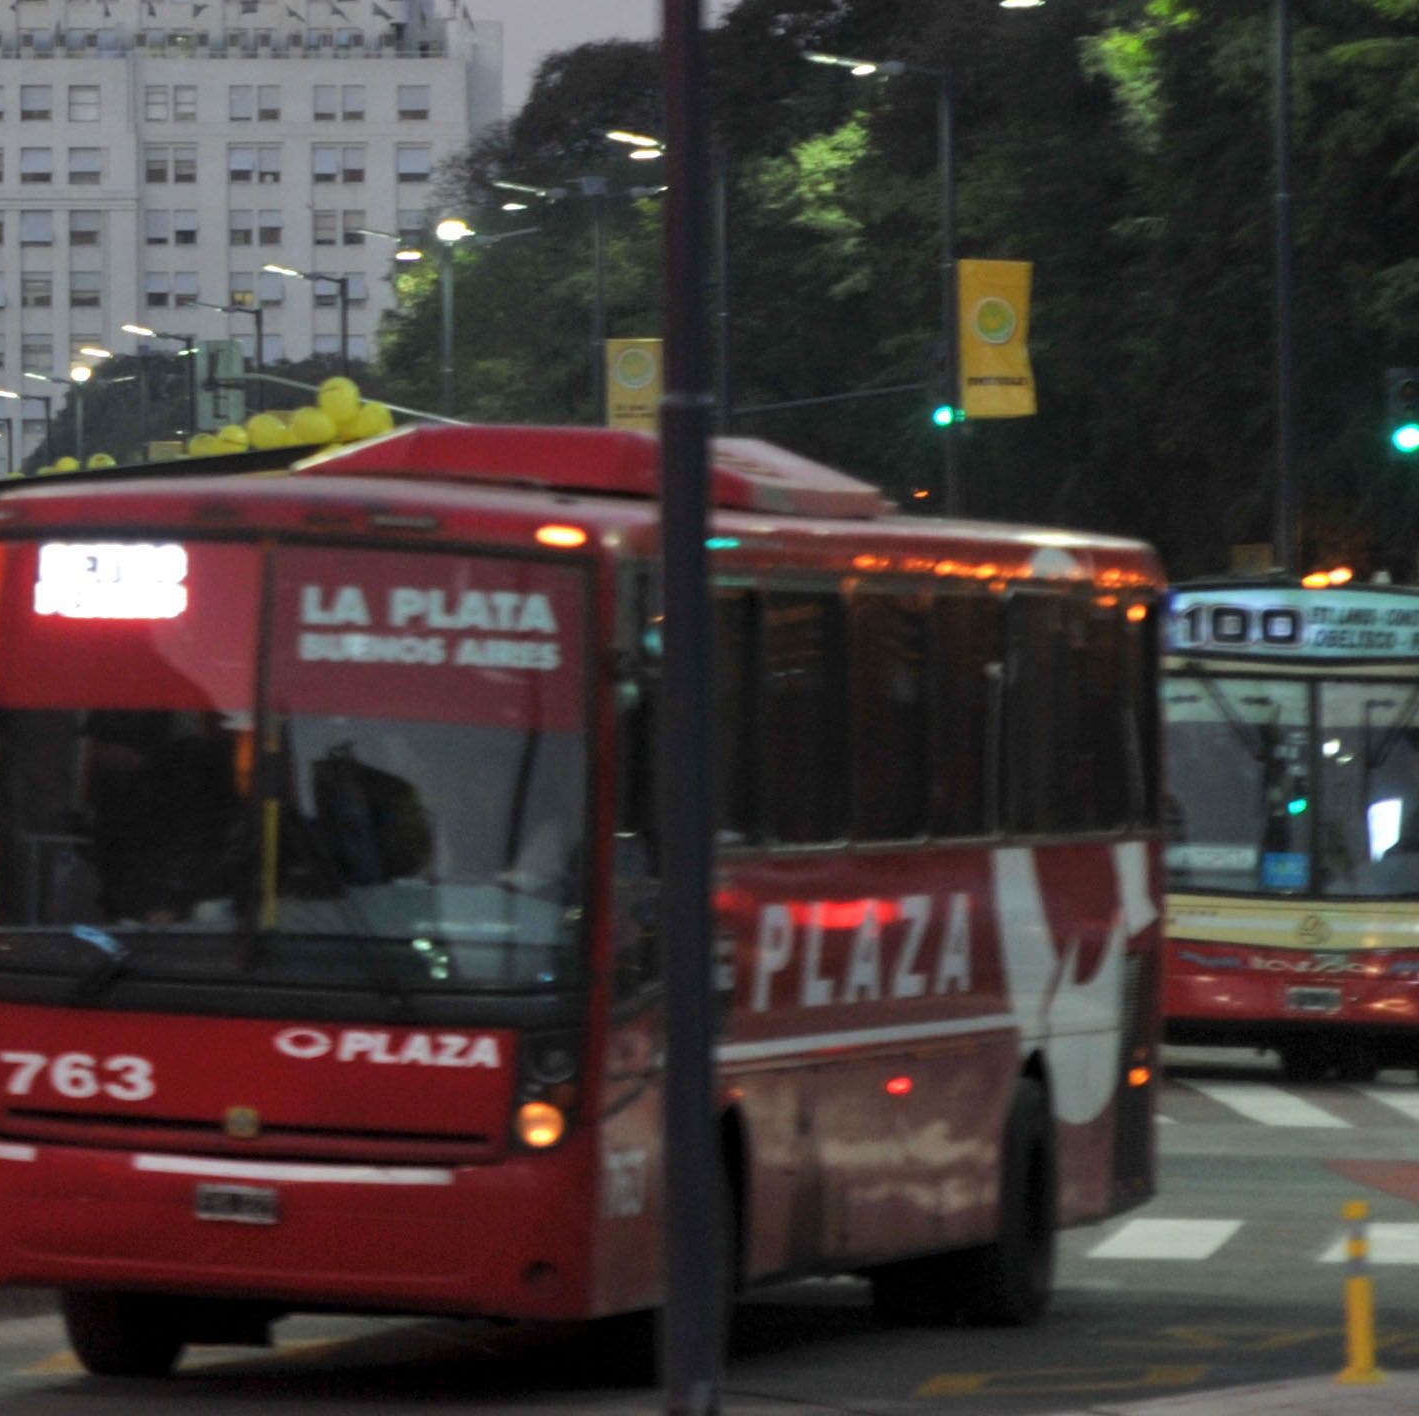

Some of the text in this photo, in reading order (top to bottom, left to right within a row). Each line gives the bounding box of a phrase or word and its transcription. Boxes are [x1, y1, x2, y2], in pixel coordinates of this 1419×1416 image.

[302, 585, 557, 632] LA PLATA
[1175, 602, 1304, 648] 100
[299, 633, 560, 670] BUENOS AIRES
[752, 893, 971, 1013] PLAZA
[336, 1028, 501, 1069] PLAZA
